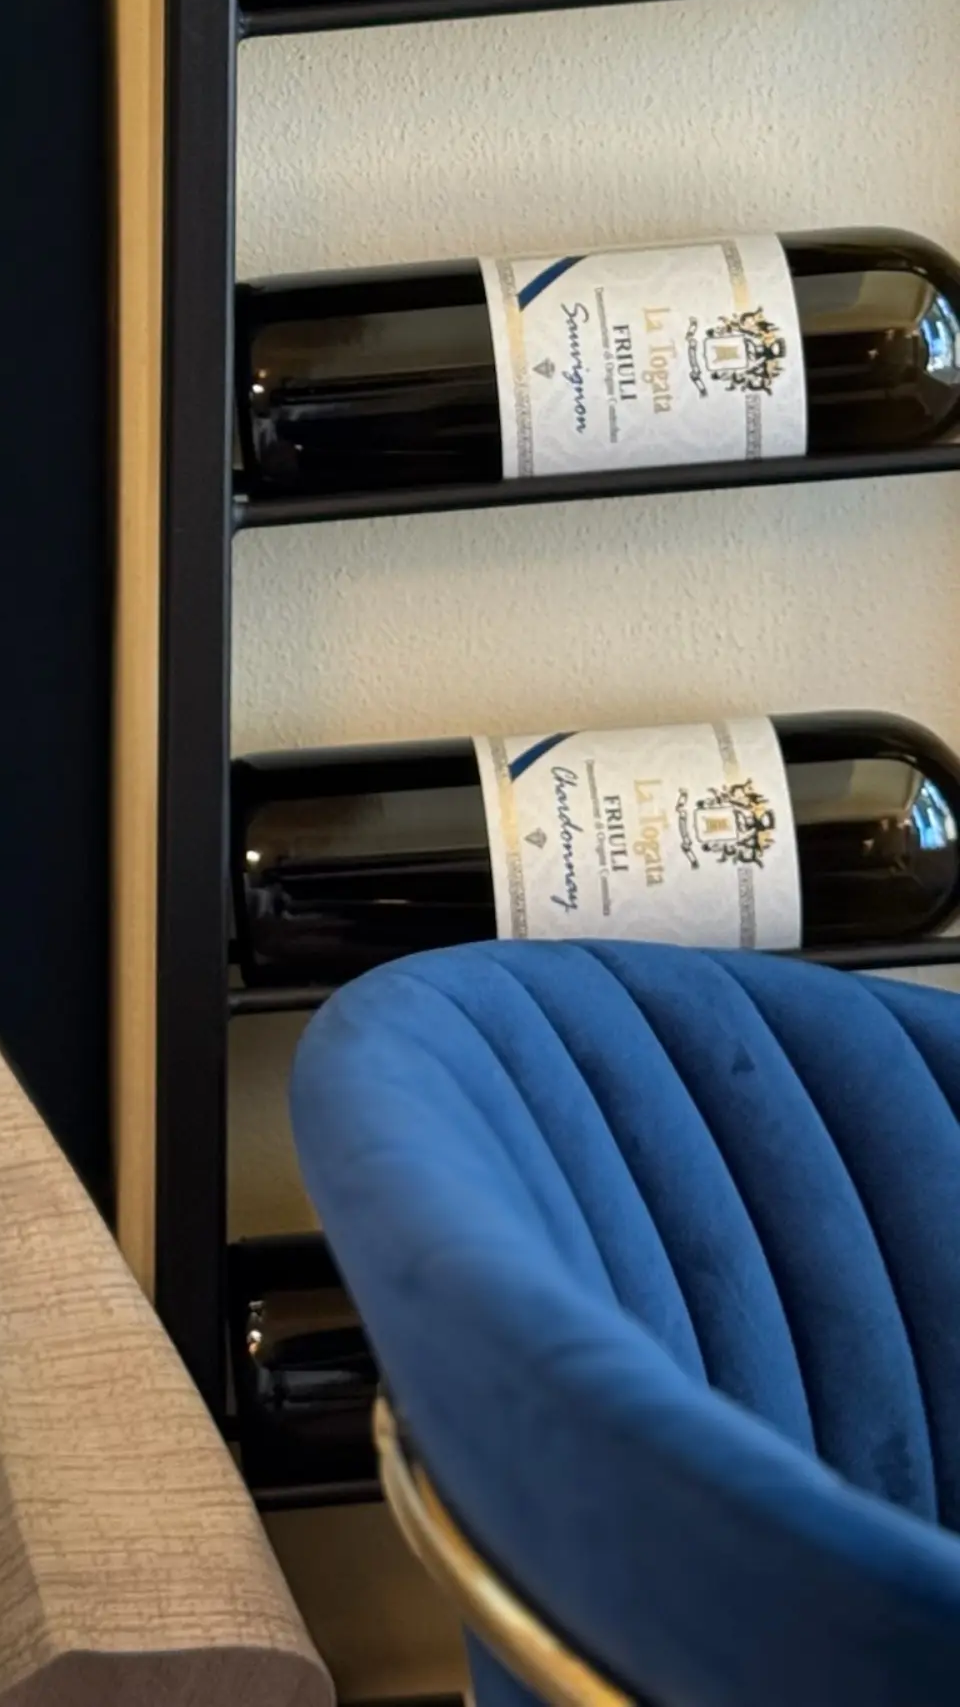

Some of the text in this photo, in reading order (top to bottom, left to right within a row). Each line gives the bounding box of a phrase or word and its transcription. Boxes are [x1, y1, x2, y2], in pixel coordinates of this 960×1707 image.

[561, 303, 590, 433] Sauvignon
[613, 325, 636, 400] FRIULI
[642, 307, 677, 414] La Togata
[550, 766, 583, 912] Chardonnay
[604, 795, 629, 872] FRIULI
[633, 779, 668, 887] La Togata
